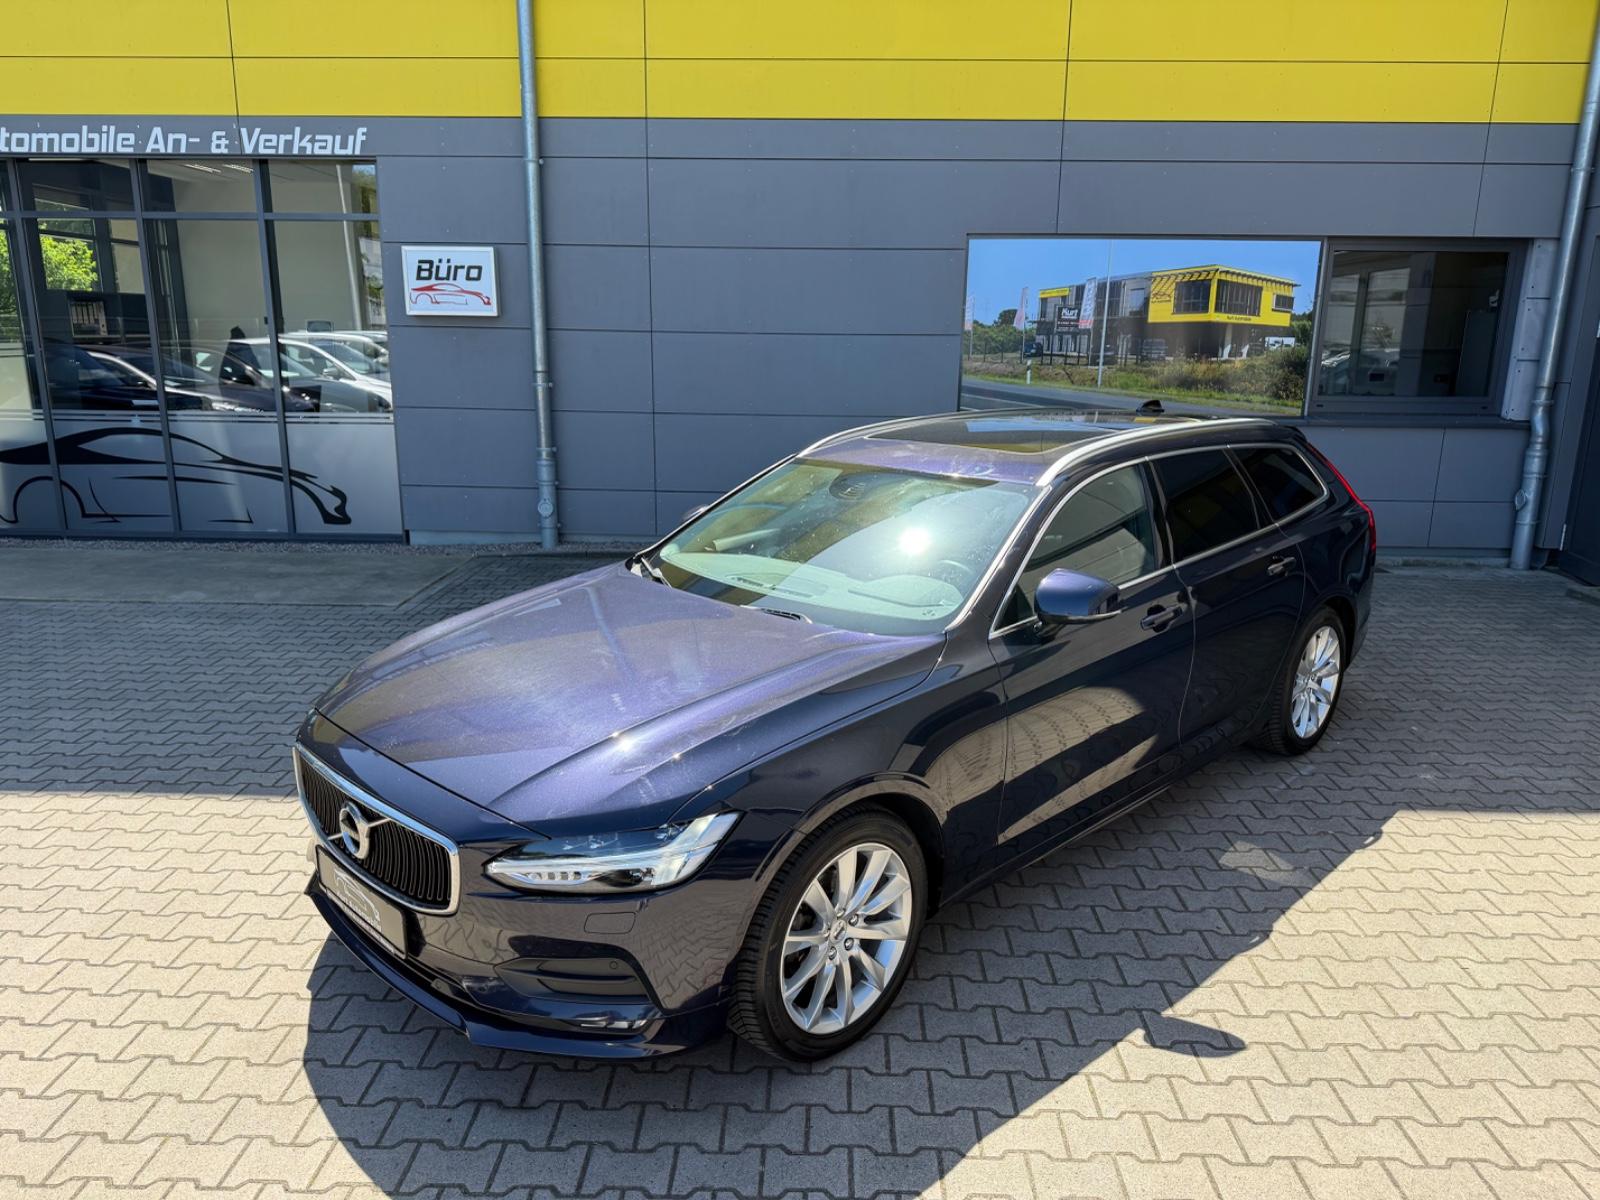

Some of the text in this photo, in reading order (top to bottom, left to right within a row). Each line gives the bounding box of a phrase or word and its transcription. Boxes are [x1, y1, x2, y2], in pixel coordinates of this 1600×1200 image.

[145, 126, 200, 154] An-
[210, 131, 229, 154] &
[240, 127, 367, 155] Verkauf
[416, 258, 482, 281] Büro
